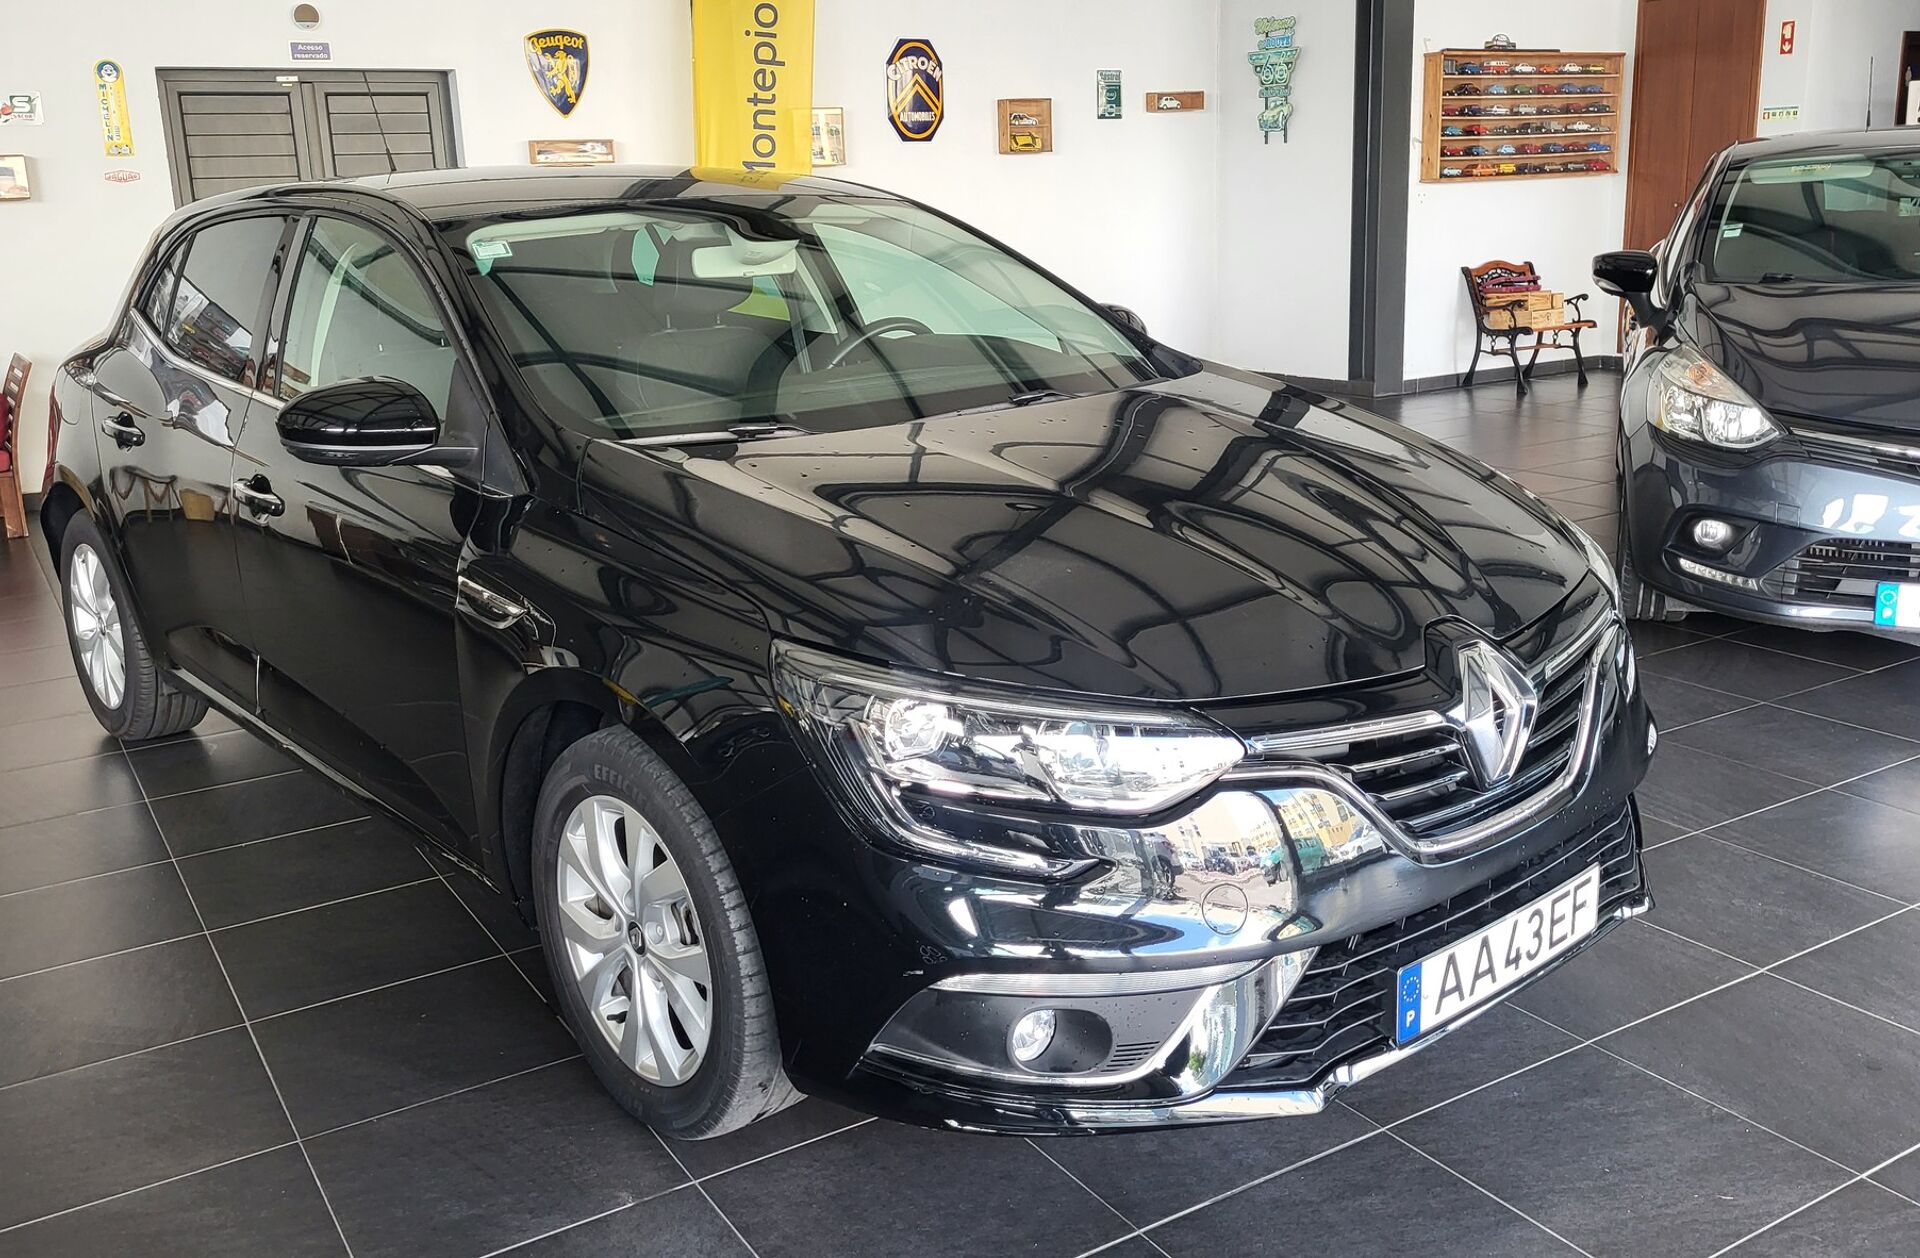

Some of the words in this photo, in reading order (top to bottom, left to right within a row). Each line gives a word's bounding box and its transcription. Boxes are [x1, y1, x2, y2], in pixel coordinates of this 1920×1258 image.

[529, 34, 584, 55] Peugeot
[1261, 52, 1288, 84] 66
[98, 83, 114, 141] MICHELIN
[899, 111, 936, 122] AUTOMOBILES
[1405, 1010, 1416, 1029] P
